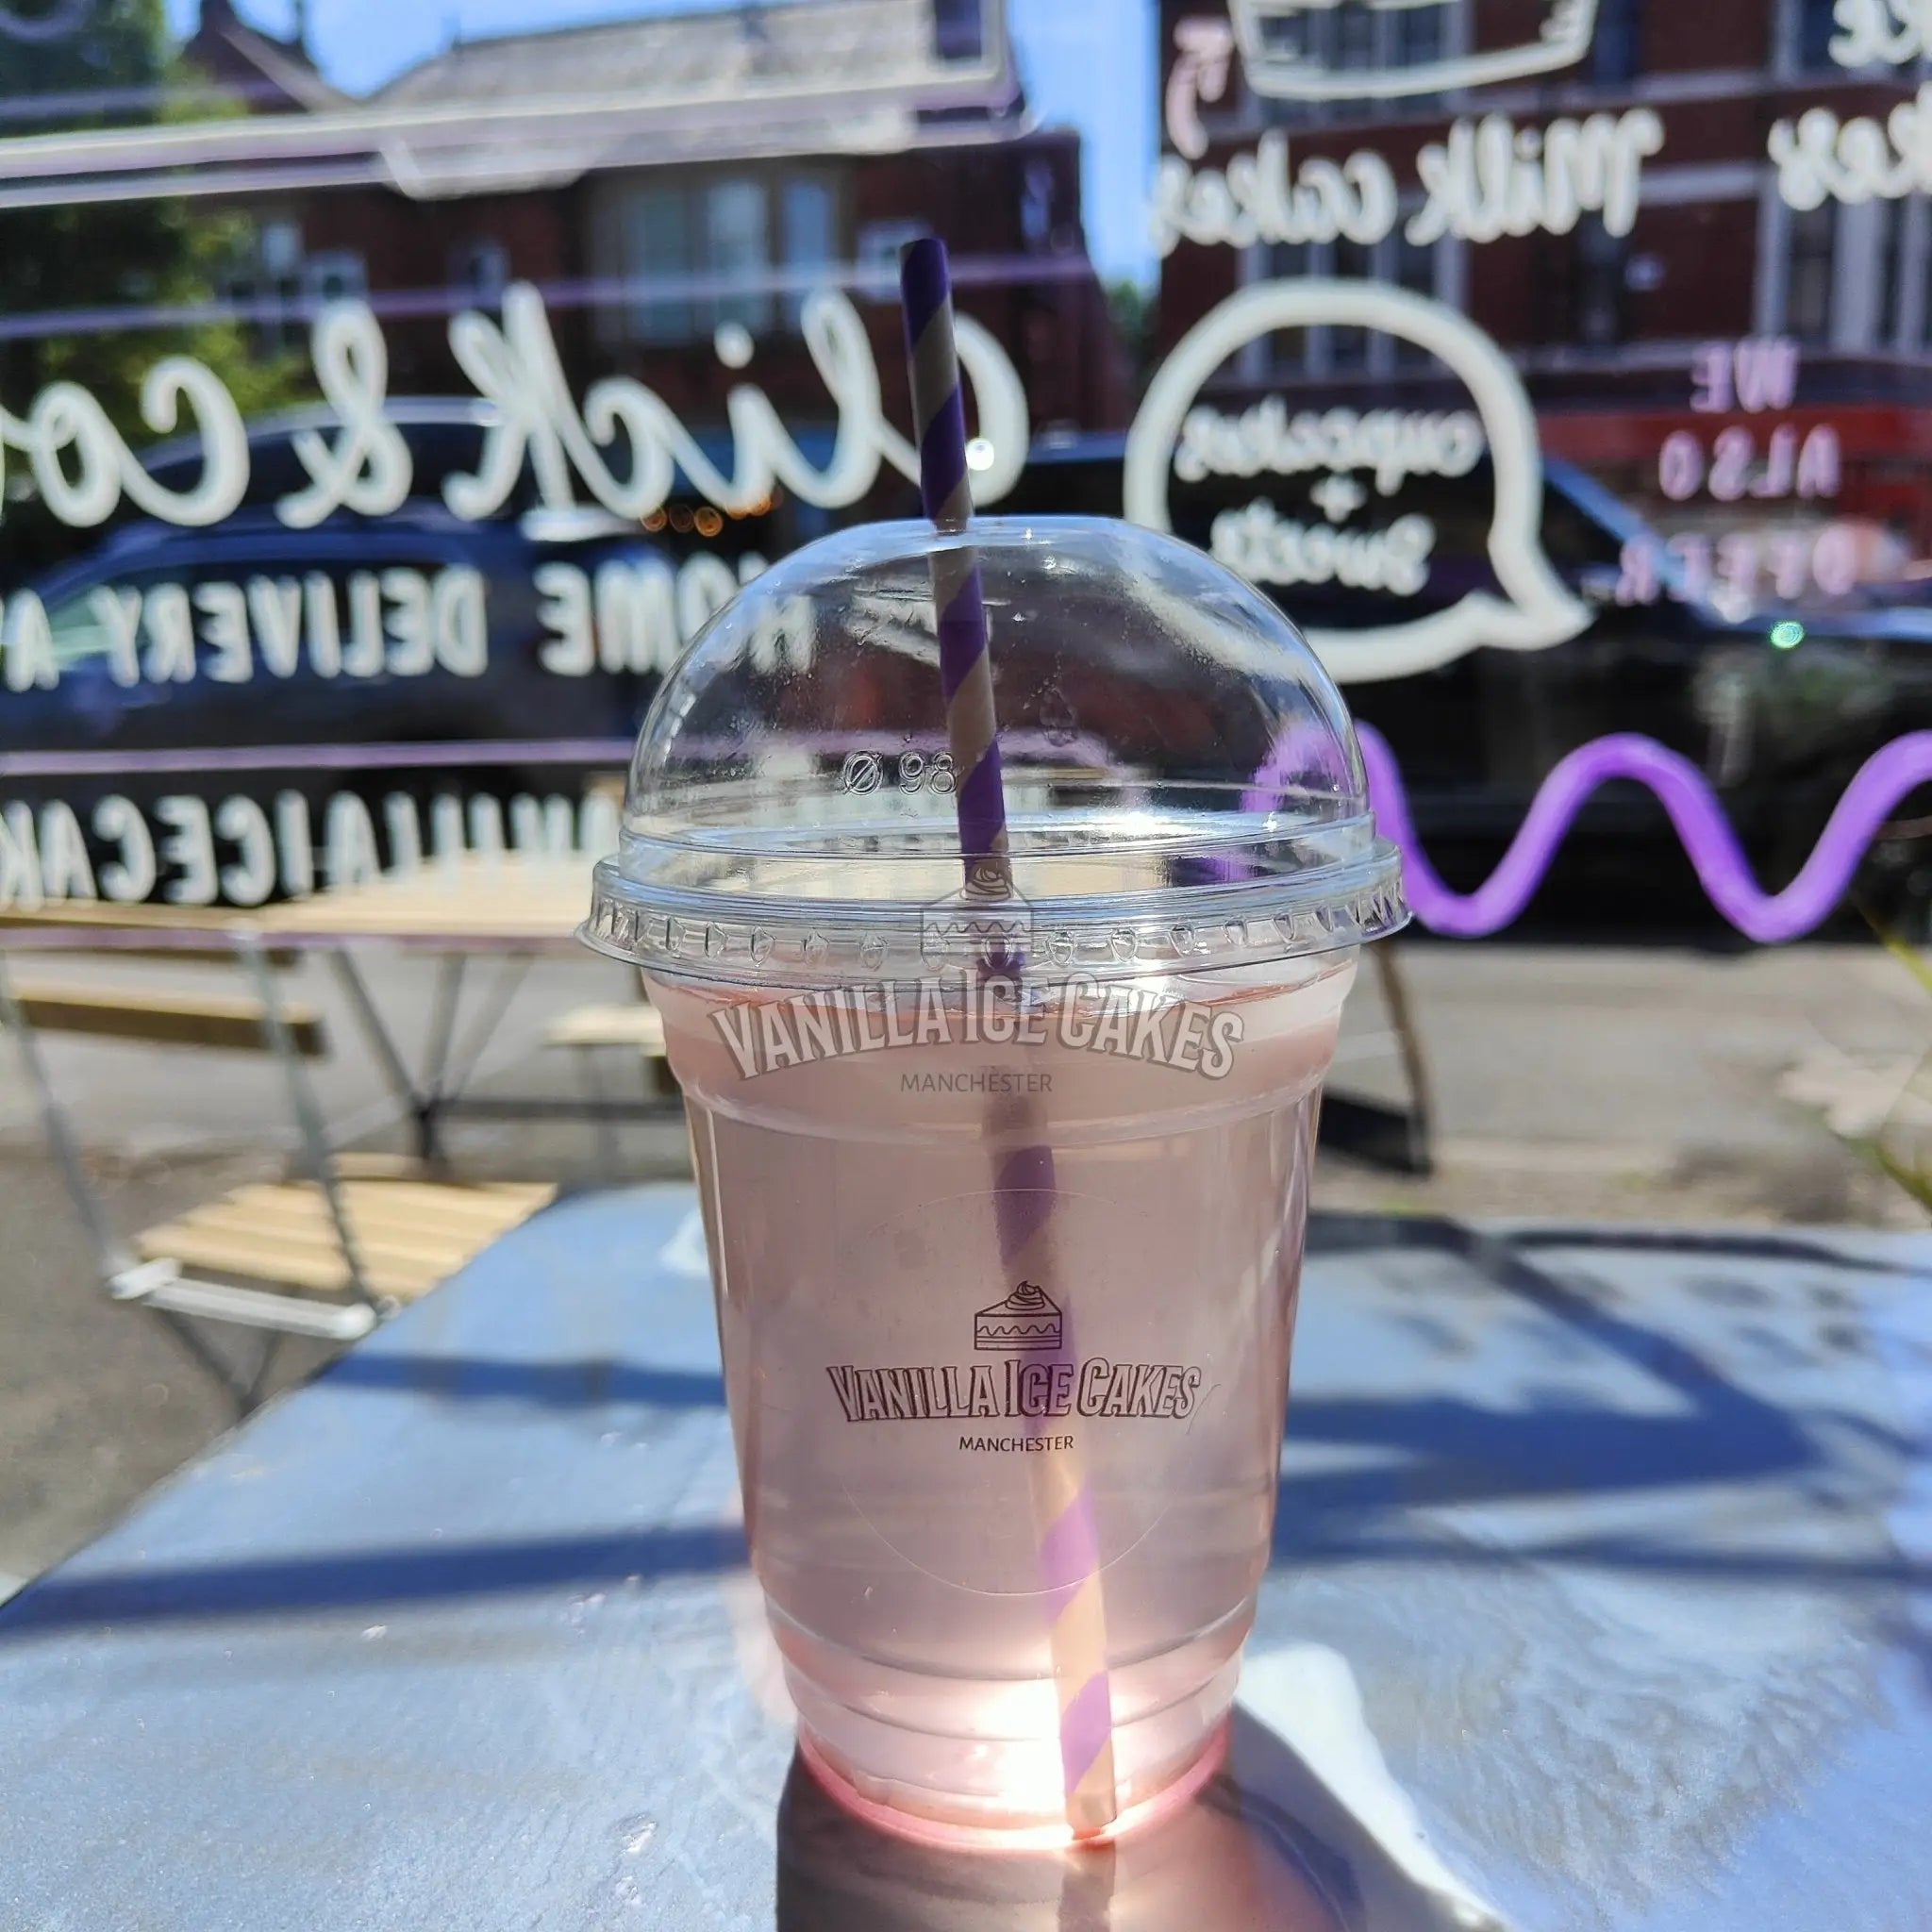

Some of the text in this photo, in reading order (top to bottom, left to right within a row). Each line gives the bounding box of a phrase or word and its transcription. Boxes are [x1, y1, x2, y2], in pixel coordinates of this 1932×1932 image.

[899, 750, 958, 794] 98
[826, 1357, 1202, 1422] VANILLA ICE CAKES
[958, 1435, 1074, 1452] MANCHESTER
